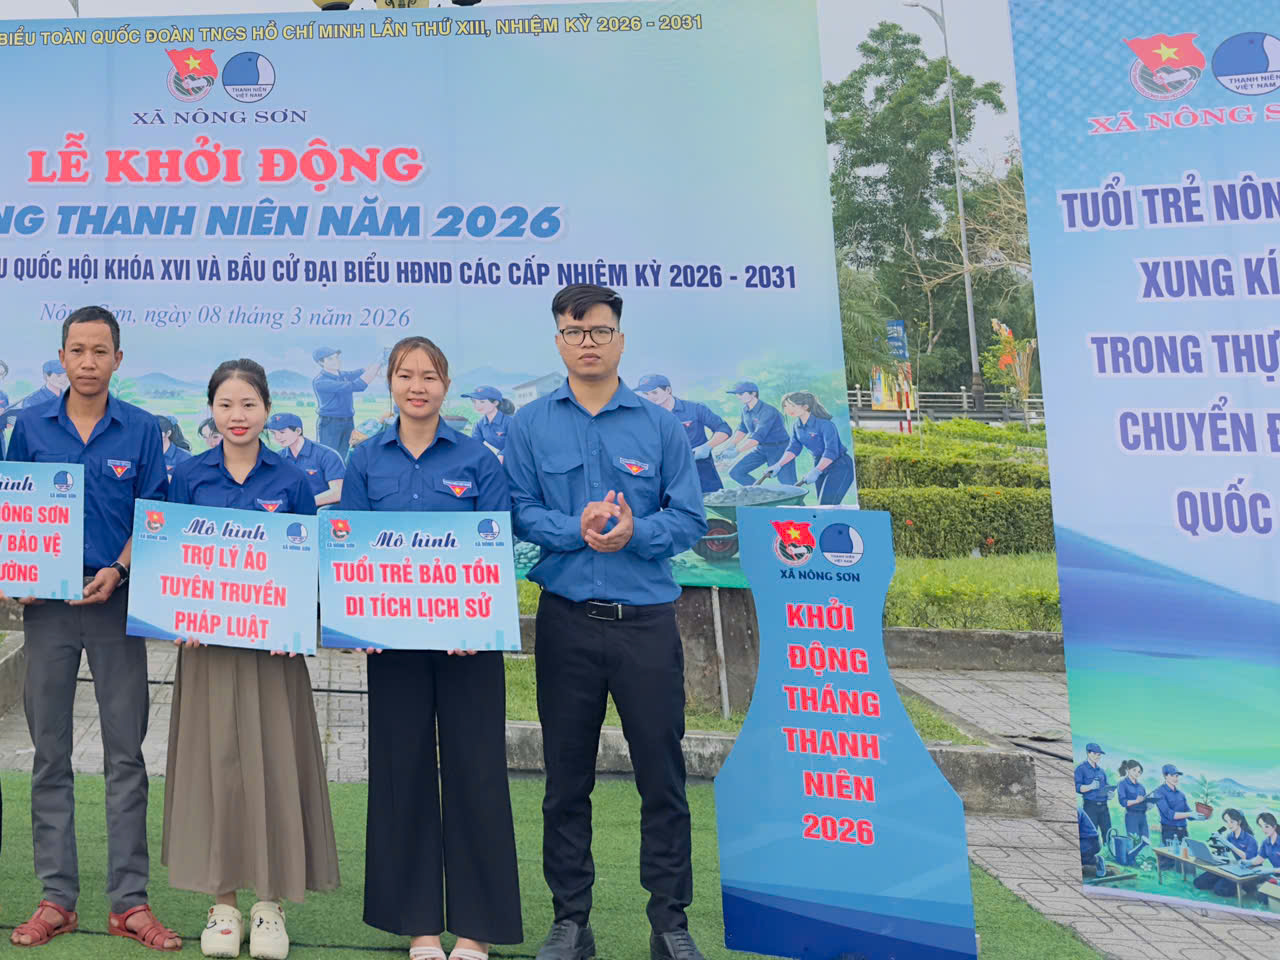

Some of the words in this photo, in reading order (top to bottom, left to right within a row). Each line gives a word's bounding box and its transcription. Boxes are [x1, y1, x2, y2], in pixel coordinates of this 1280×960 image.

[40, 25, 86, 45] TOÀN
[91, 24, 140, 45] QUỐC
[145, 25, 194, 43] ĐOÀN
[199, 26, 247, 42] TNCS
[252, 19, 278, 40] HỒ
[282, 21, 316, 39] CHÍ
[319, 23, 365, 39] MINH
[371, 17, 407, 38] LẦN
[412, 19, 451, 37] THỨ
[455, 18, 492, 38] XIII,
[496, 16, 559, 37] NHIỆM
[565, 12, 592, 33] KỲ
[597, 15, 643, 32] 2026
[659, 13, 703, 31] 2031
[1229, 76, 1258, 84] THANH
[1257, 81, 1276, 89] NAM
[132, 108, 166, 125] XÃ
[173, 106, 247, 124] NÔNG
[254, 108, 308, 124] SƠN
[1090, 111, 1138, 134] XÃ
[1146, 105, 1255, 130] NÔNG
[28, 132, 90, 183] LỄ
[105, 135, 242, 183] KHỞI
[259, 138, 423, 192] ĐỘNG
[1062, 176, 1134, 228] TUỔI
[1142, 173, 1204, 224] TRẺ
[56, 204, 198, 236] THANH
[205, 197, 309, 237] NIÊN
[318, 195, 421, 237] NĂM
[431, 205, 562, 239] 2026
[14, 249, 62, 280] QUỐC
[68, 253, 98, 284] HỘI
[104, 254, 154, 281] KHÓA
[161, 259, 191, 281] XVI
[197, 254, 221, 281] VÀ
[227, 252, 266, 282] BẦU
[272, 252, 300, 282] CỬ
[304, 261, 338, 287] ĐẠI
[344, 252, 390, 283] BIỂU
[396, 261, 453, 284] HĐND
[459, 253, 501, 286] CÁC
[507, 254, 550, 286] CẤP
[557, 257, 628, 287] NHIỆM
[635, 257, 663, 287] KỲ
[669, 266, 723, 288] 2026
[744, 266, 797, 289] 2031
[1140, 258, 1235, 298] XUNG
[144, 305, 192, 327] ngày
[198, 305, 222, 324] 08
[227, 306, 285, 329] tháng
[290, 308, 302, 325] 3
[308, 307, 352, 326] năm
[360, 308, 411, 327] 2026
[1091, 335, 1203, 374] TRONG
[1120, 396, 1257, 452] CHUYỂN
[37, 504, 69, 524] SƠN
[1177, 478, 1273, 536] QUỐC
[7, 529, 38, 553] BẢO
[43, 532, 61, 557] VỆ
[184, 518, 216, 536] Mô
[222, 520, 267, 541] hình
[372, 531, 405, 548] Mô
[411, 530, 458, 548] hình
[181, 543, 215, 571] TRỢ
[219, 545, 239, 569] LÝ
[243, 544, 268, 571] ẢO
[333, 555, 374, 583] TUỔI
[379, 556, 413, 583] TRẺ
[419, 558, 457, 584] BẢO
[462, 558, 500, 584] TỒN
[160, 575, 215, 600] TUYÊN
[220, 580, 287, 607] TRUYỀN
[780, 568, 795, 579] XÃ
[798, 569, 833, 581] NÔNG
[836, 572, 860, 582] SƠN
[346, 596, 364, 616] DI
[370, 593, 411, 617] TÍCH
[417, 598, 459, 622] LỊCH
[465, 592, 492, 618] SỬ
[786, 597, 854, 631] KHỞI
[174, 610, 220, 634] PHÁP
[227, 615, 269, 642] LUẬT
[788, 641, 869, 676] ĐỘNG
[783, 683, 880, 718] THÁNG
[782, 727, 880, 760] THANH
[804, 769, 875, 802] NIÊN
[803, 814, 875, 846] 2026
